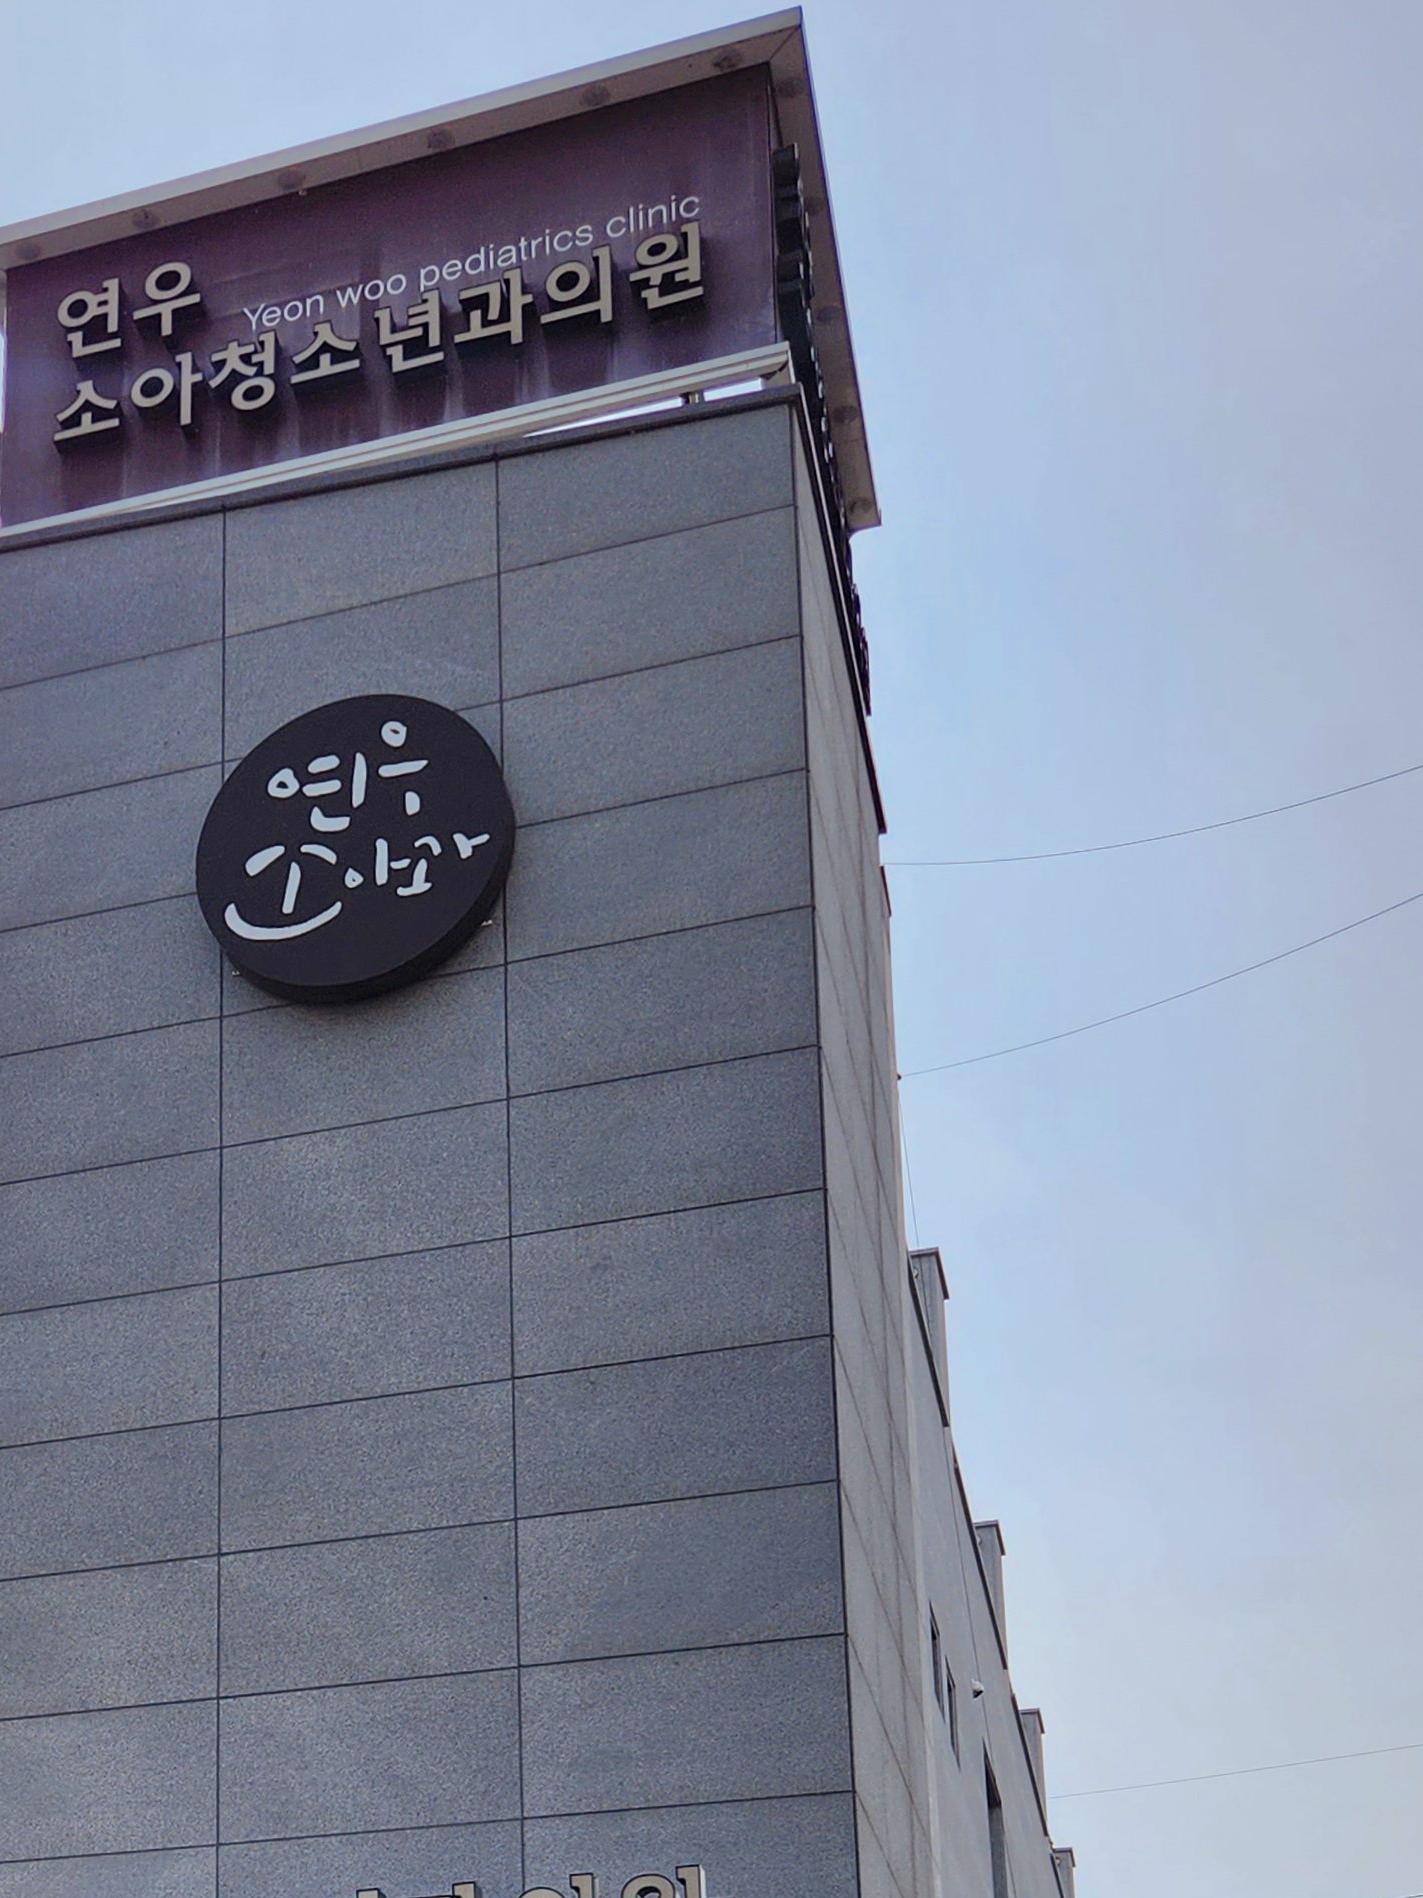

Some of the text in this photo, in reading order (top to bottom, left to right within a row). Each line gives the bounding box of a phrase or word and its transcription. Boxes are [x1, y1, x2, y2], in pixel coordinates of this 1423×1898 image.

[55, 259, 202, 360] 연우
[242, 195, 702, 331] Yeon woo pediatrics clinic
[52, 220, 705, 444] 소아청소년과의원
[267, 720, 429, 832] 연우
